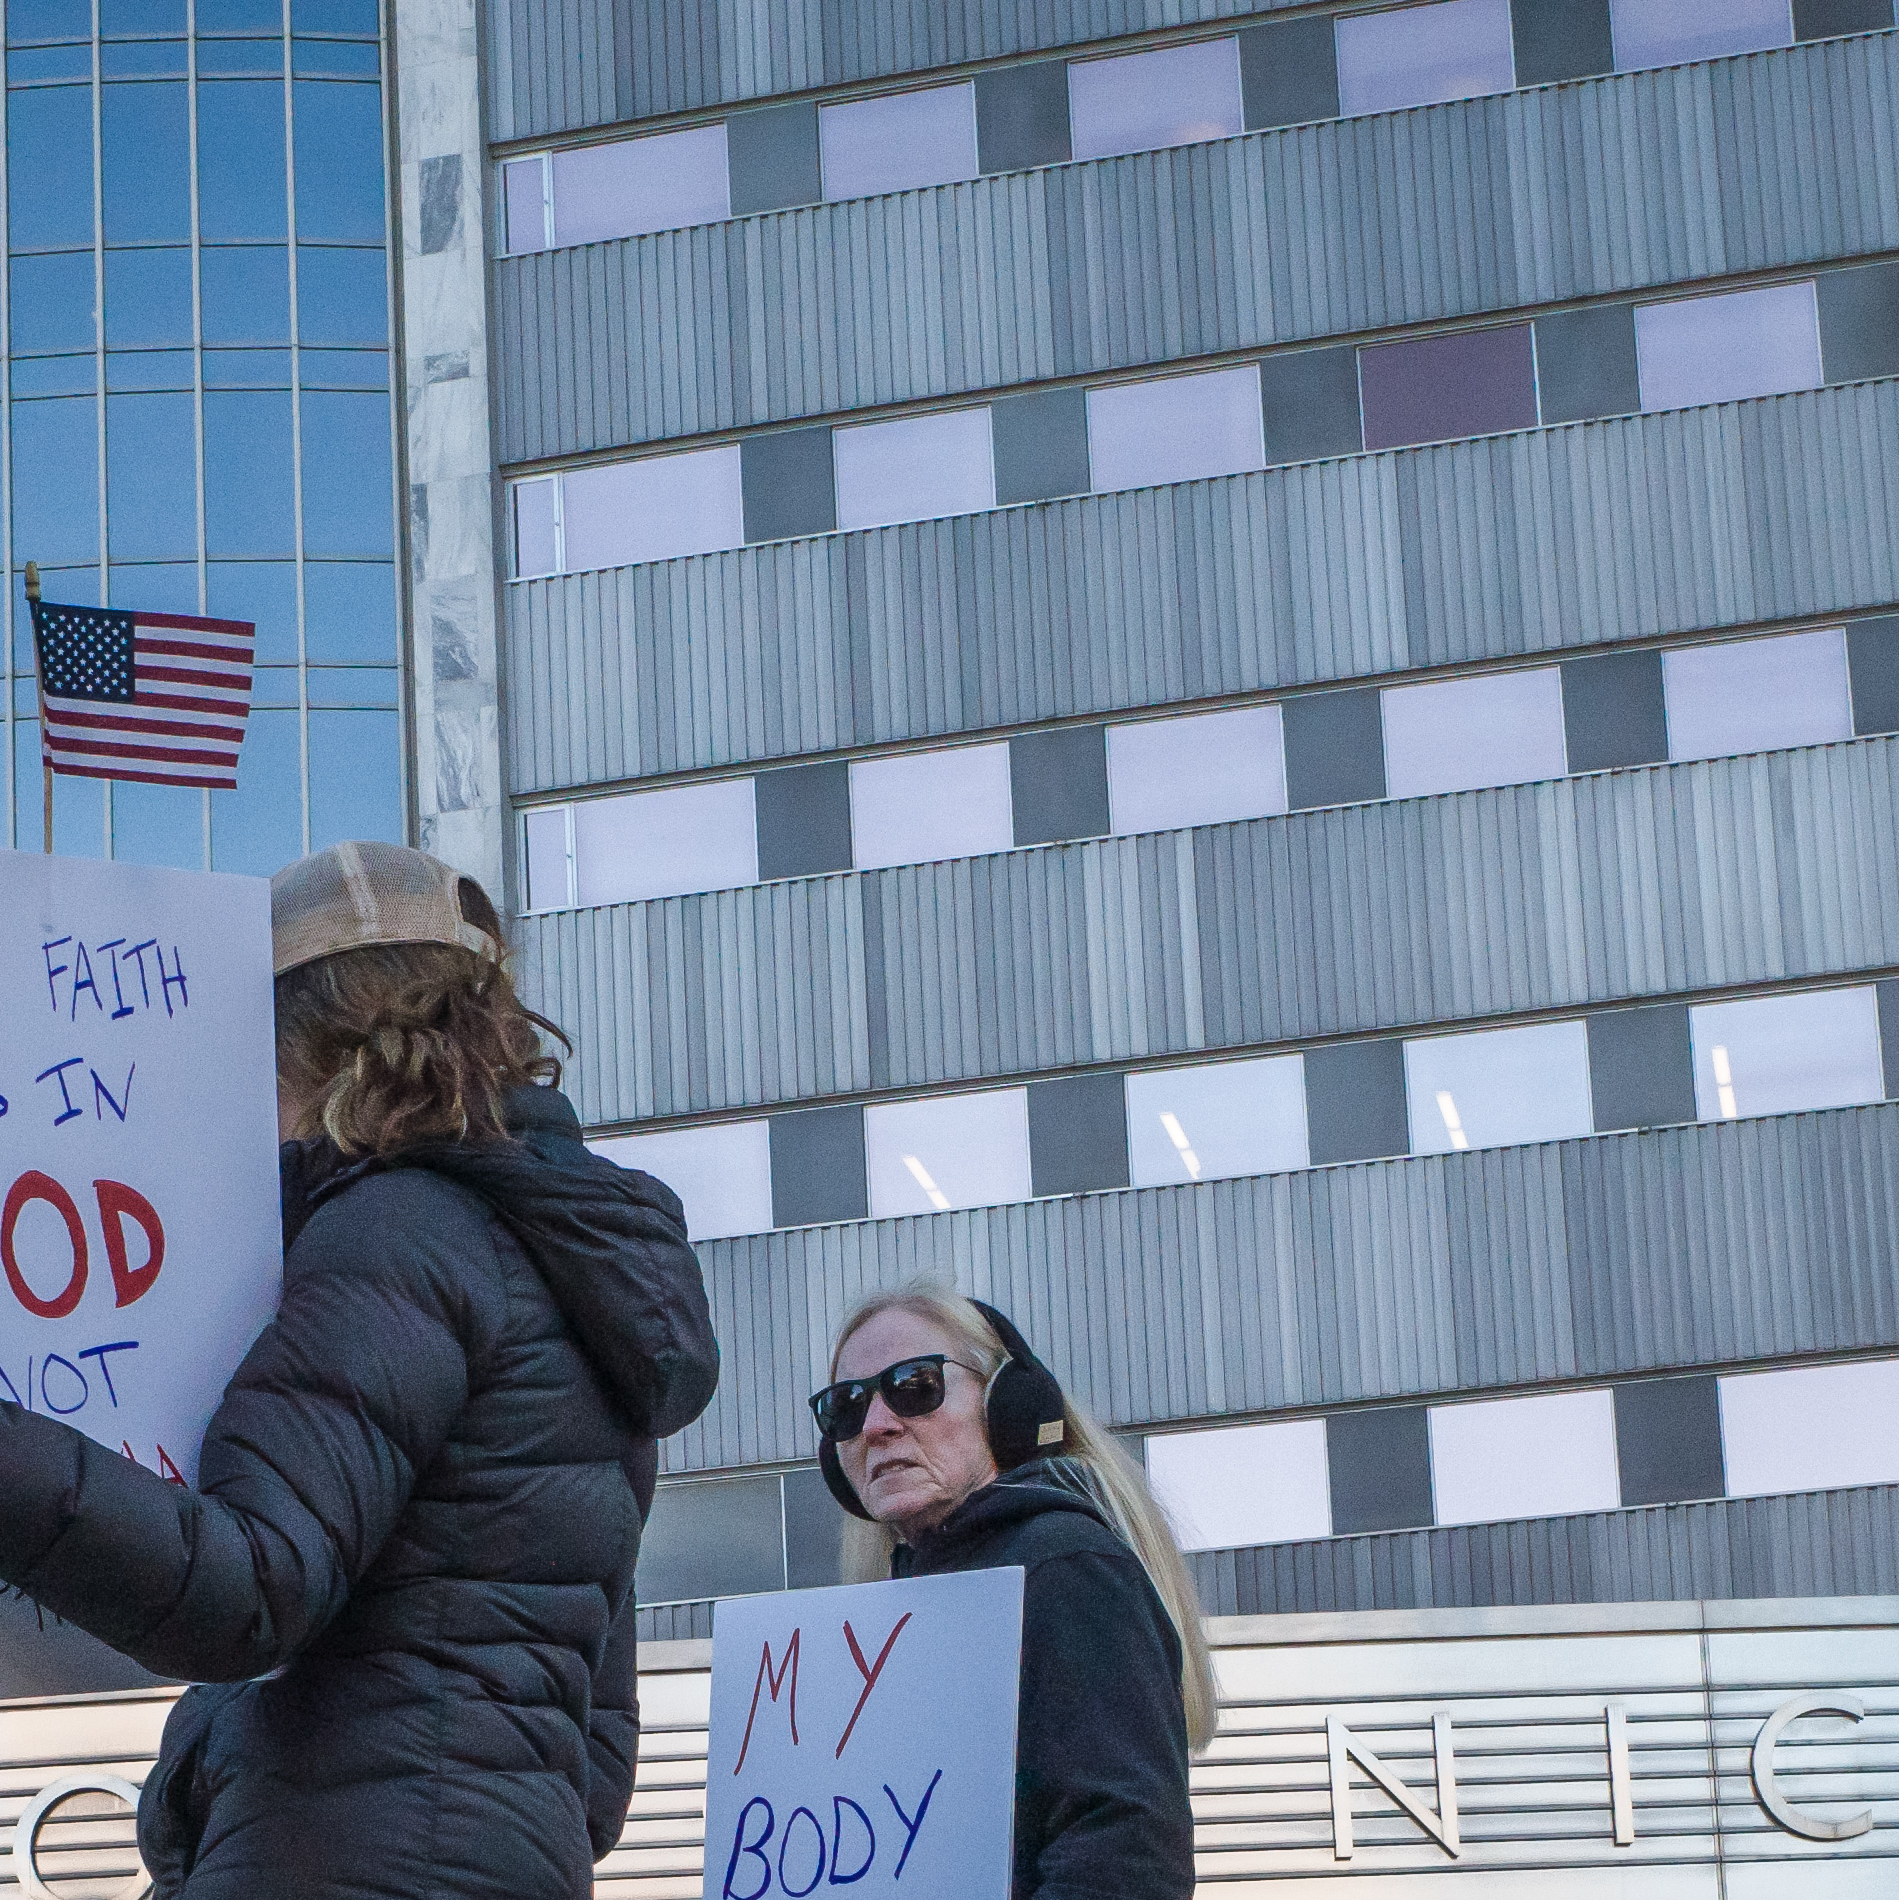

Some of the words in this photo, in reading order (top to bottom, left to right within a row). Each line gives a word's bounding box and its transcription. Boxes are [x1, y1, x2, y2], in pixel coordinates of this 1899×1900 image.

[41, 935, 189, 1021] FAITH
[35, 1057, 137, 1127] IN
[734, 1611, 913, 1776] MY
[1325, 1693, 1874, 1860] NIC
